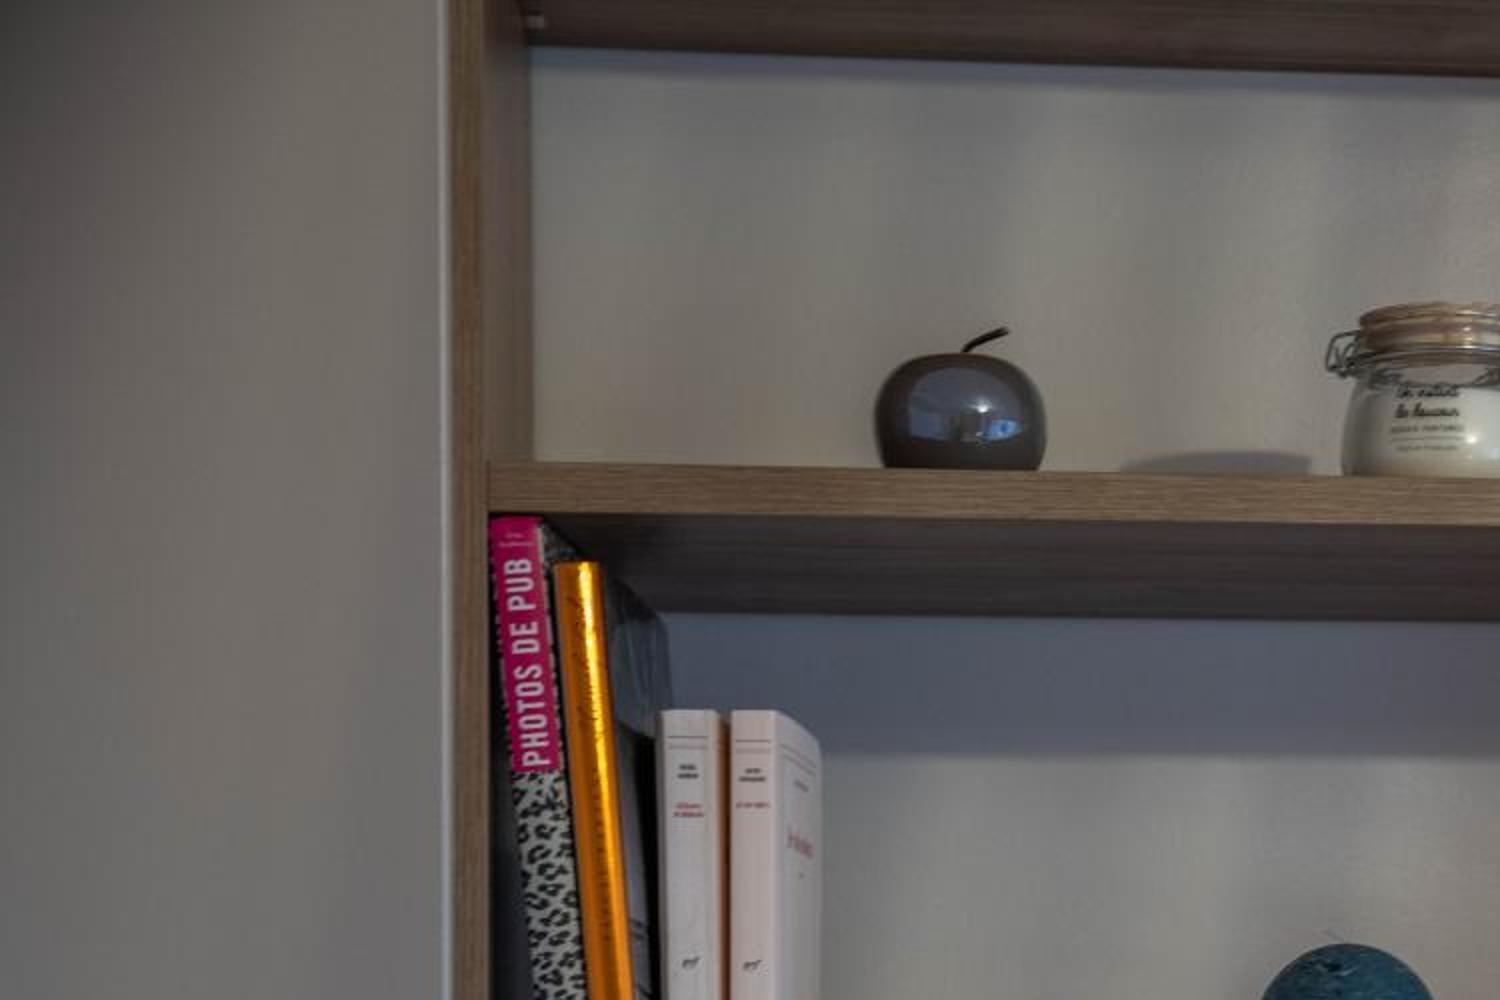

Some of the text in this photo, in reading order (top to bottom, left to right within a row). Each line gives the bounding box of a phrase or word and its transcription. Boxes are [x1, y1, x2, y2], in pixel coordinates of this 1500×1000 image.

[504, 558, 537, 612] PUB
[510, 620, 541, 655] DE
[513, 662, 550, 767] PHOTOS
